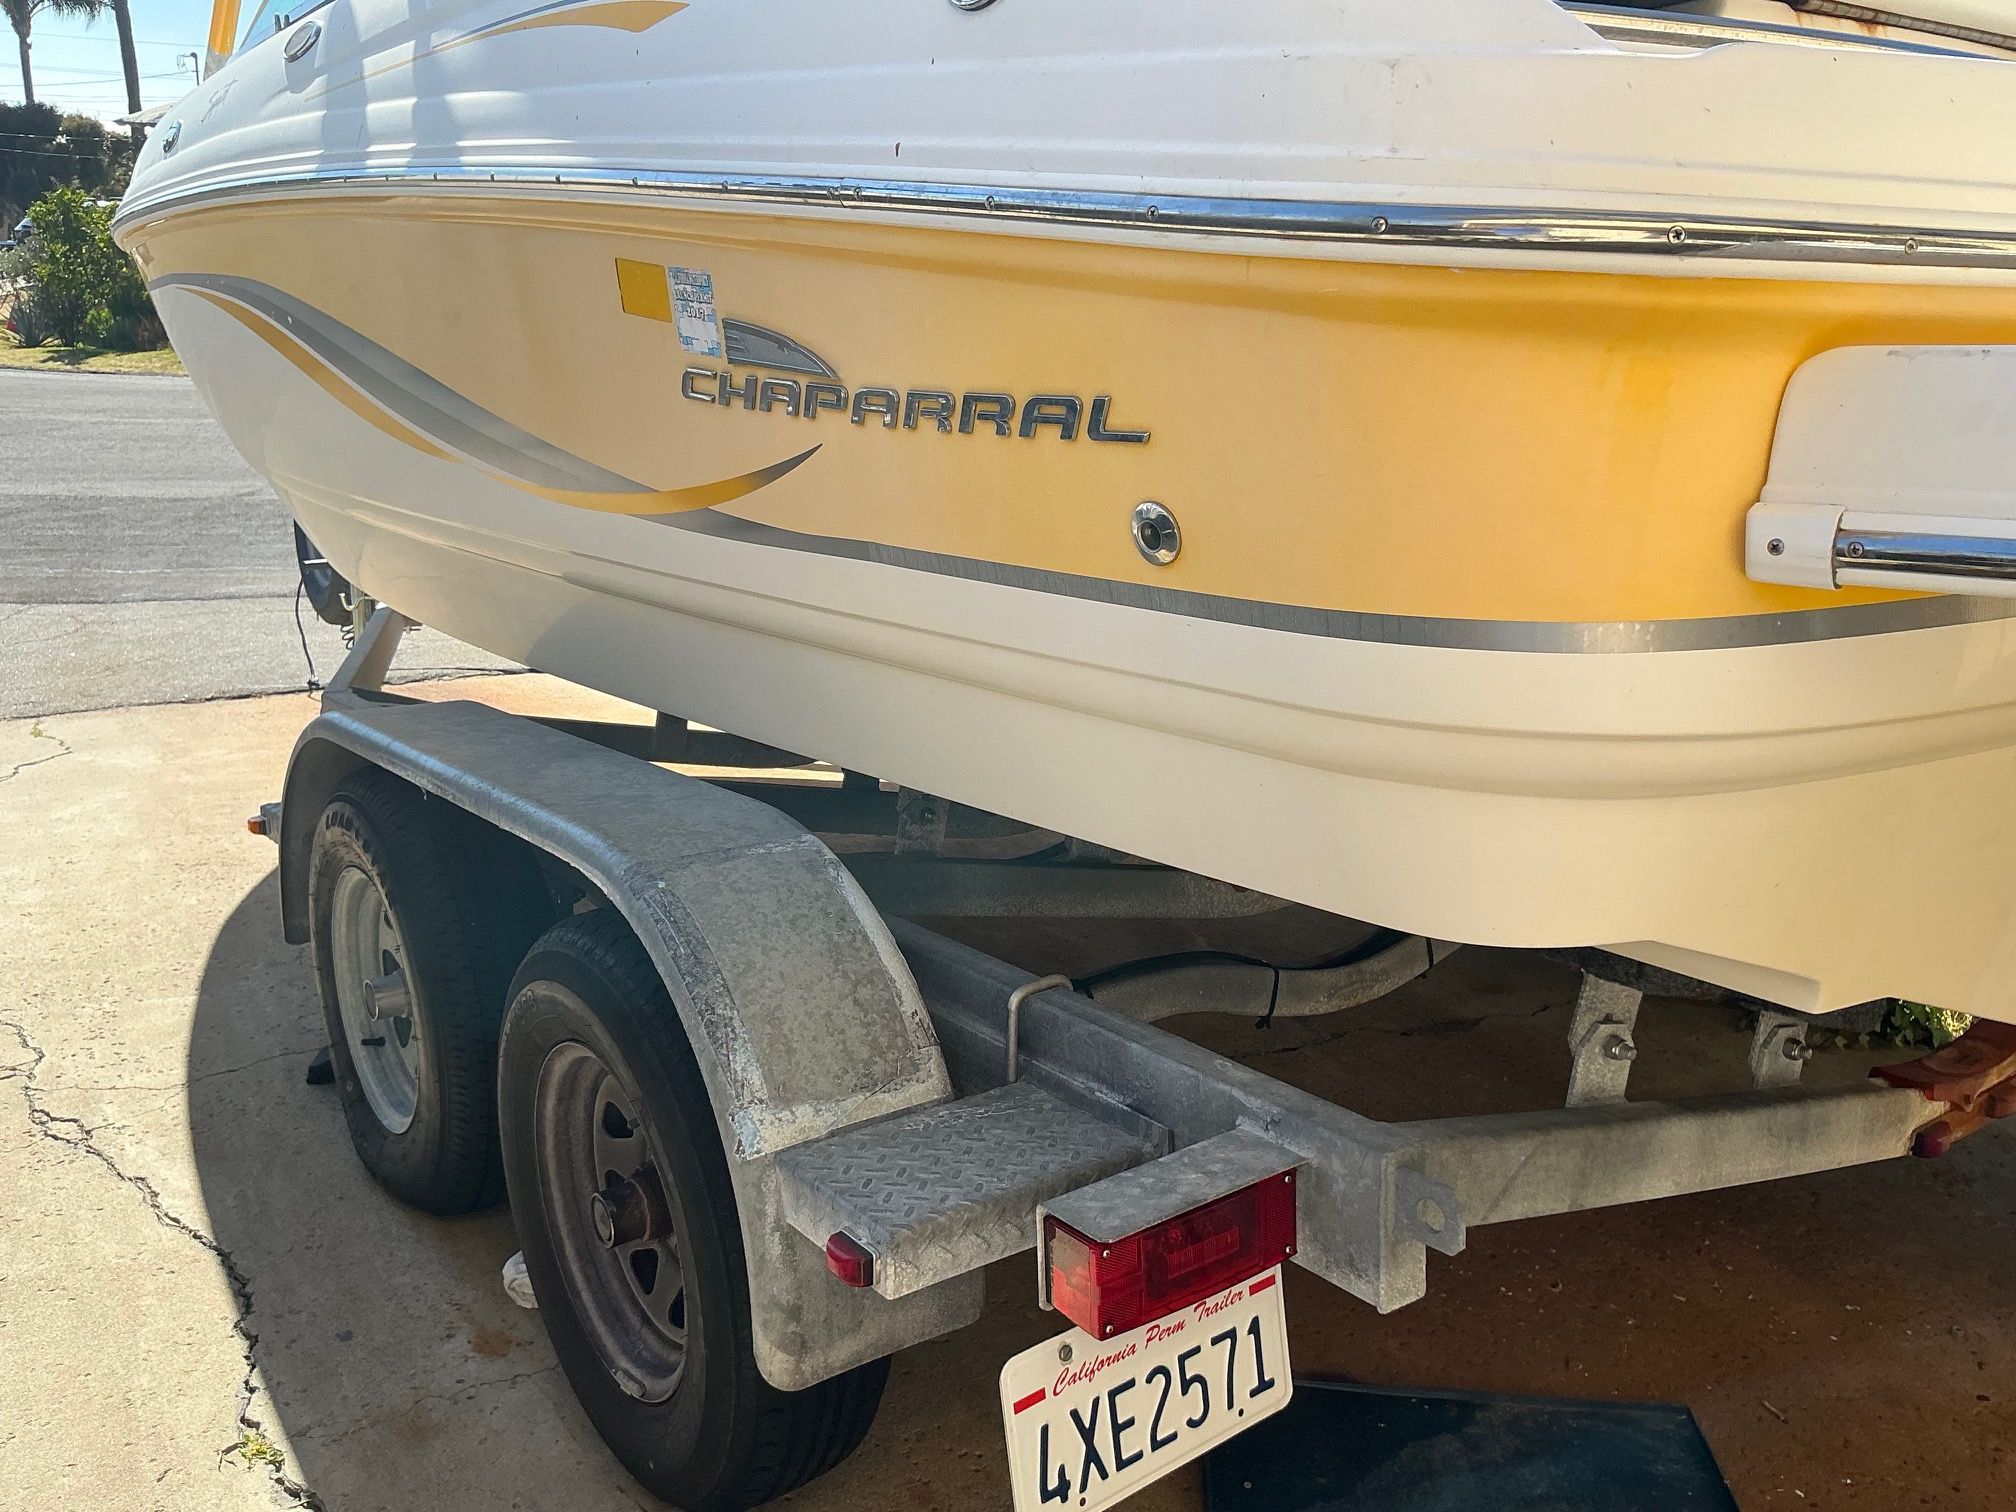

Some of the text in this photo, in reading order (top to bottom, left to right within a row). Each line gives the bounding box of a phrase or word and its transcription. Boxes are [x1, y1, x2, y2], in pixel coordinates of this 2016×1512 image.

[681, 367, 1151, 445] CHAPARRAL
[1053, 1290, 1245, 1396] California Perm Trailer
[1039, 1315, 1276, 1504] 4XE2571
